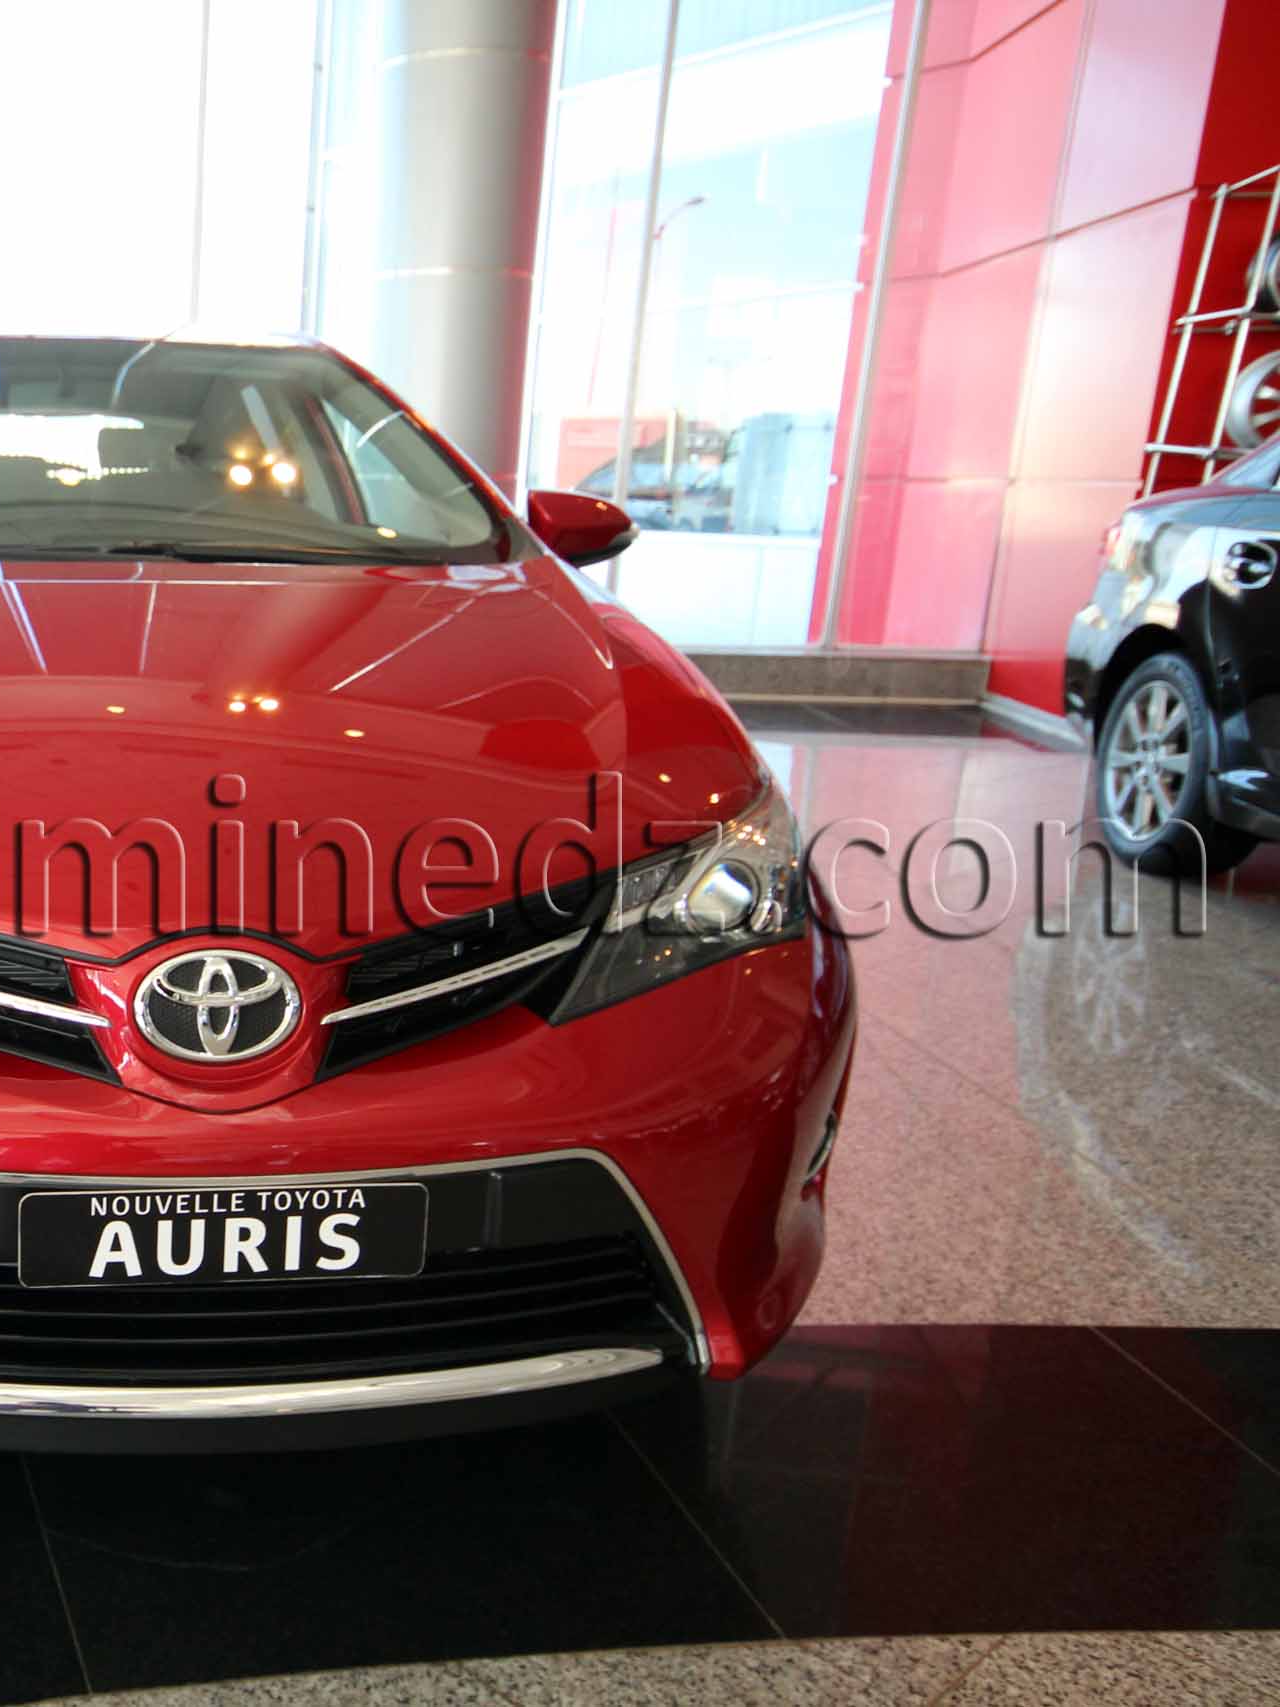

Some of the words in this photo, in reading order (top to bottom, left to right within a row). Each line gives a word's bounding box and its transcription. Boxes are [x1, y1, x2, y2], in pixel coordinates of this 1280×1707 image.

[90, 1192, 246, 1216] NOUVELLE
[258, 1189, 366, 1211] TOYOTA
[89, 1213, 362, 1278] AURIS
